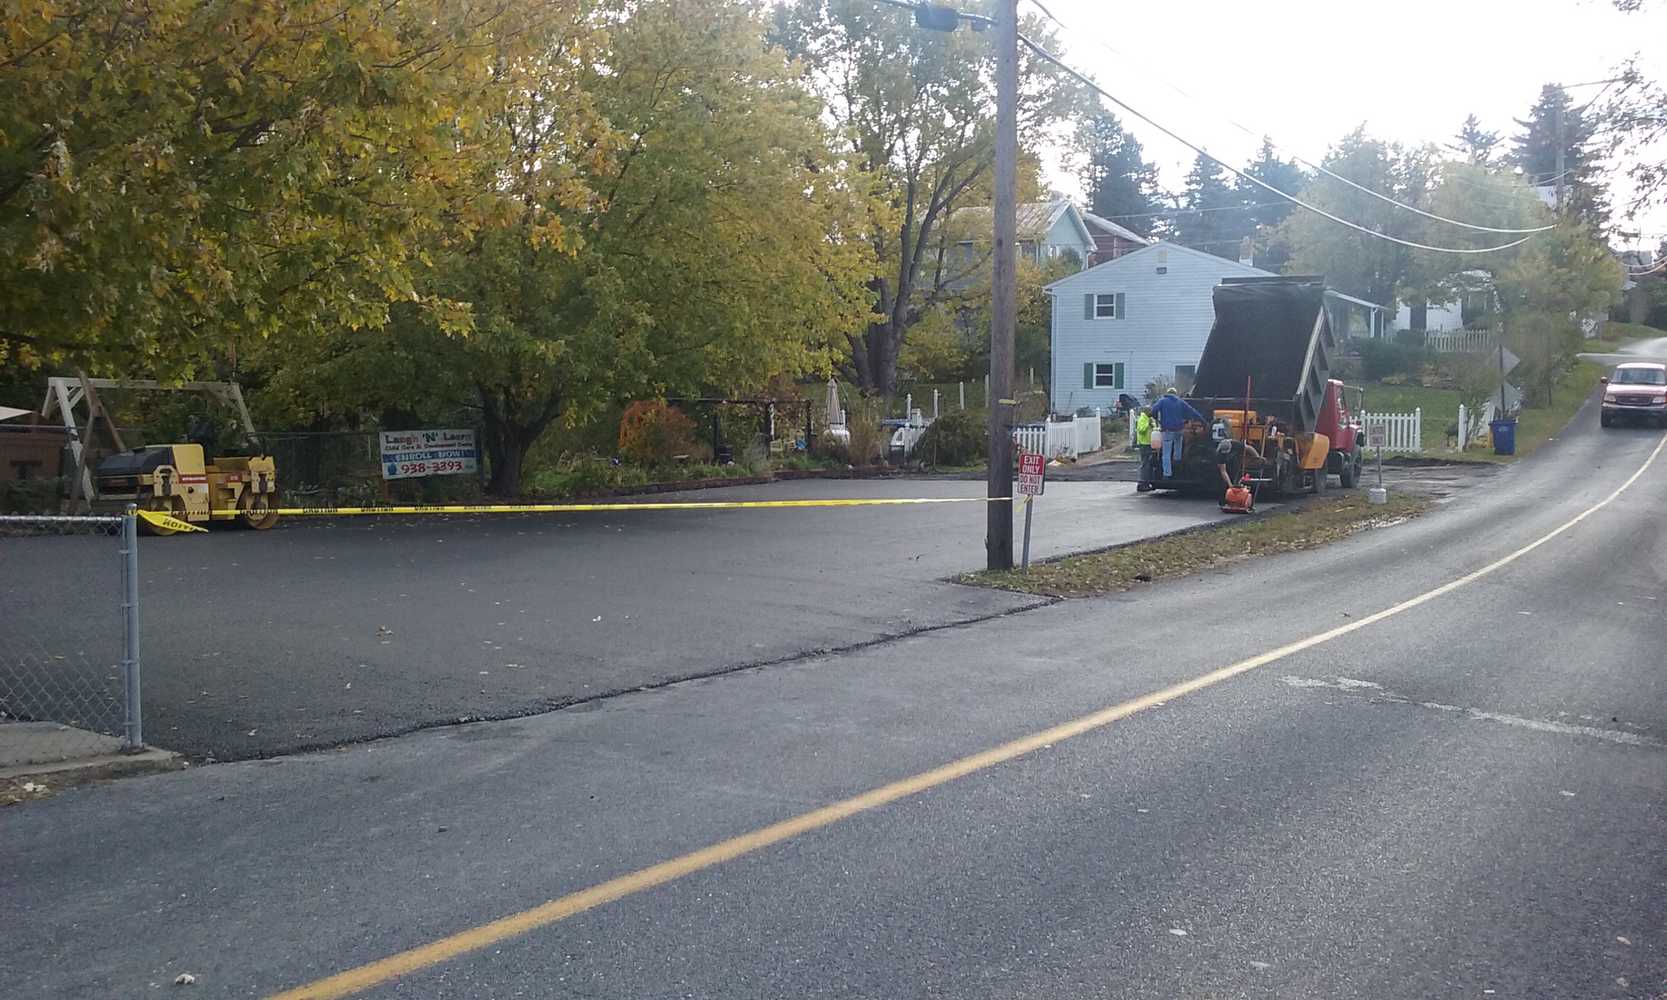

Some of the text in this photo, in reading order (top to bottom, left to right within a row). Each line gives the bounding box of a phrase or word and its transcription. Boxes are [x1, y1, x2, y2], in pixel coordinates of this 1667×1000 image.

[1024, 455, 1040, 464] EXIT
[401, 461, 464, 474] 938-3393
[1022, 464, 1040, 474] ONLY
[1020, 484, 1039, 493] ENTER
